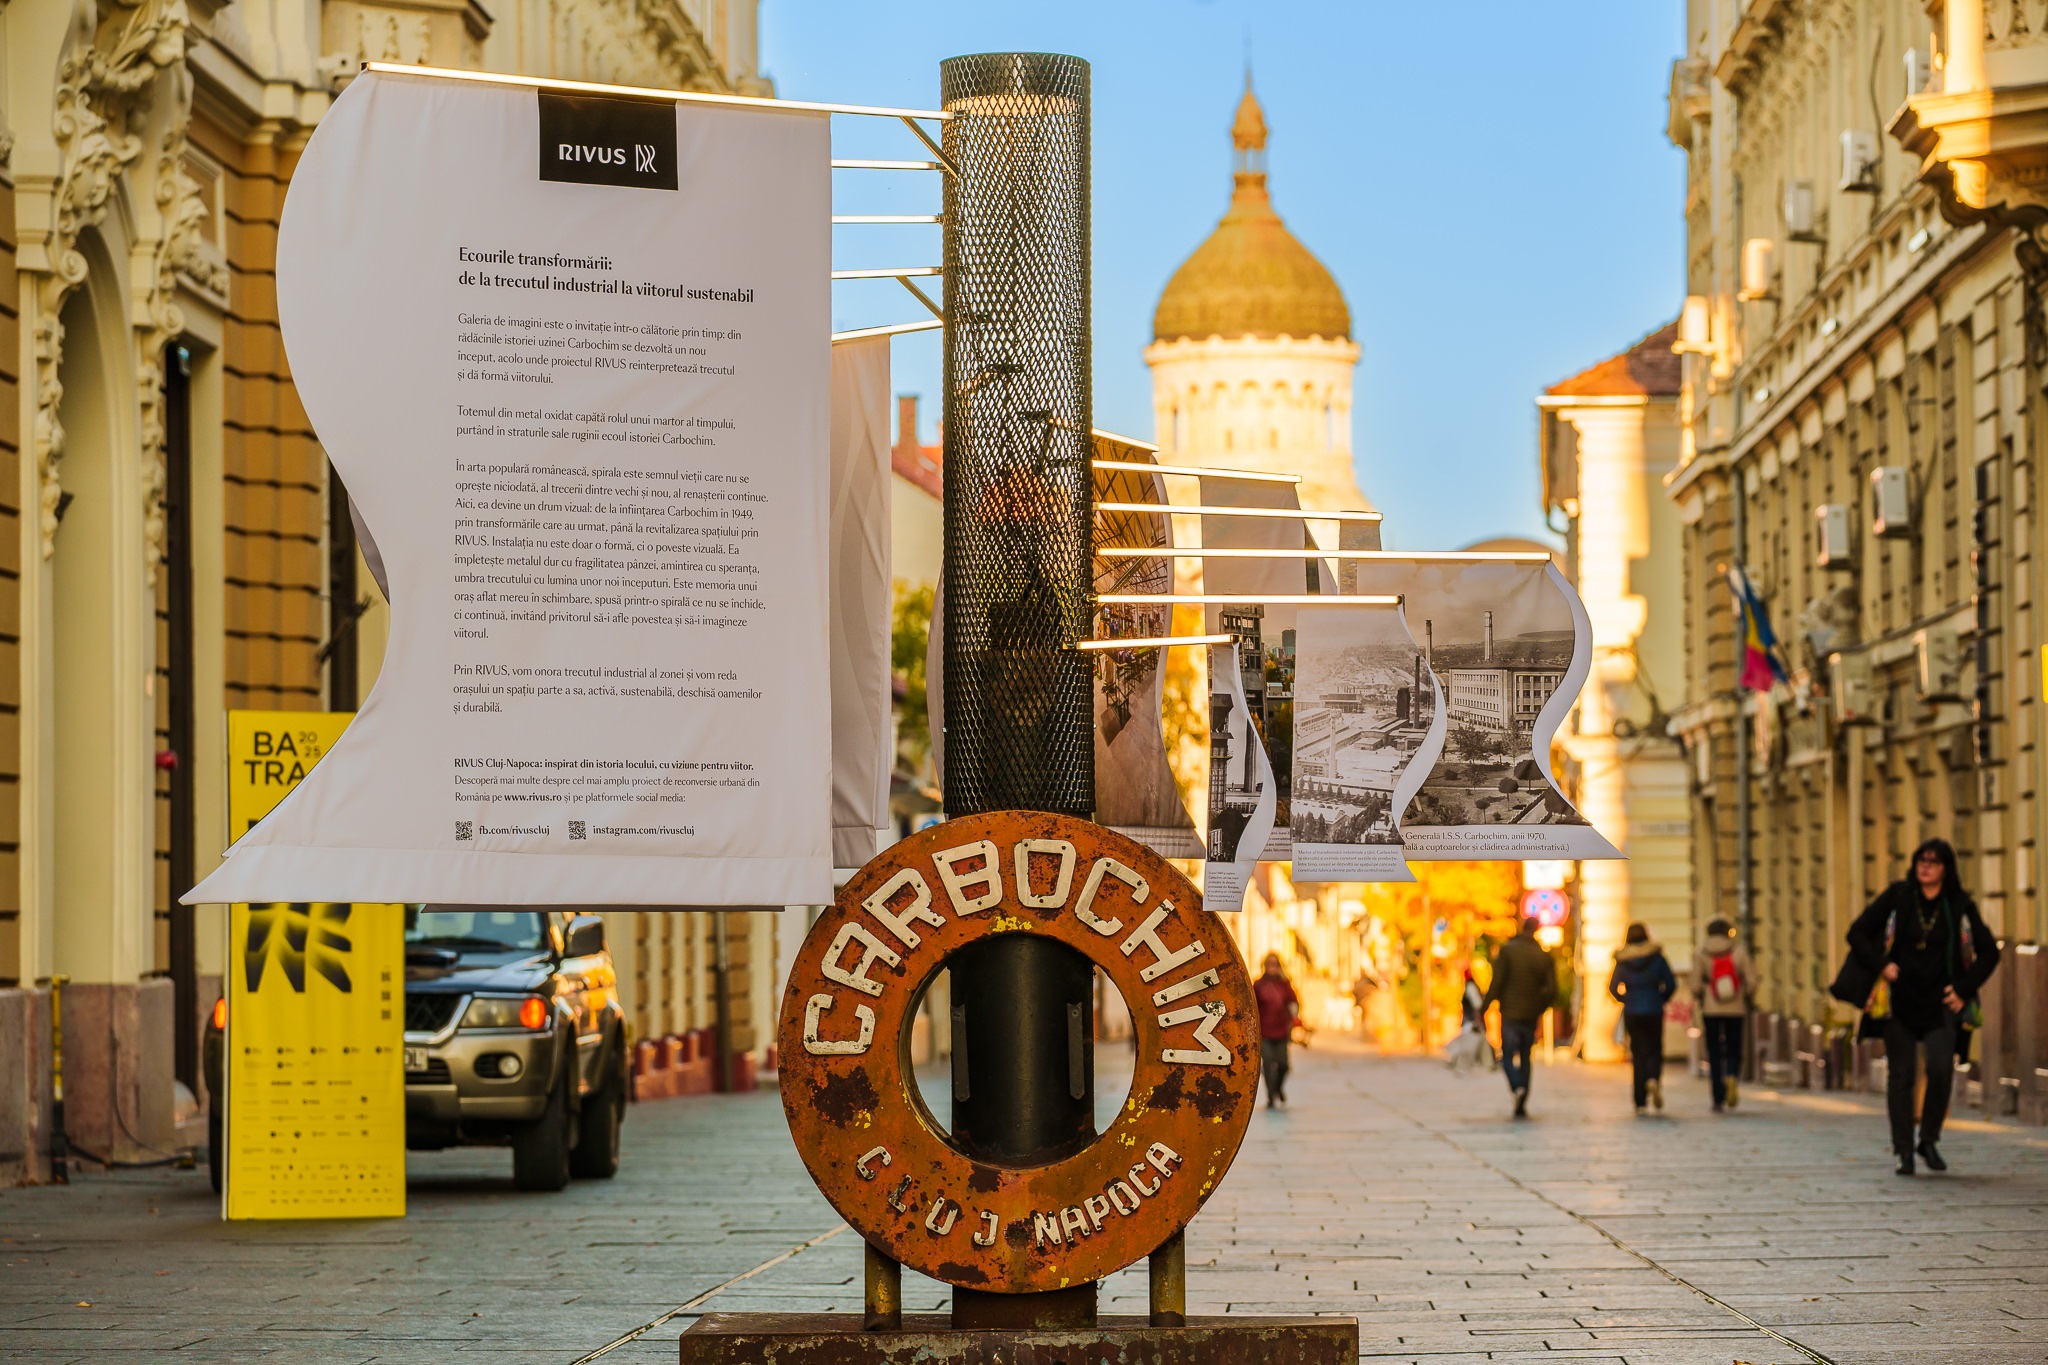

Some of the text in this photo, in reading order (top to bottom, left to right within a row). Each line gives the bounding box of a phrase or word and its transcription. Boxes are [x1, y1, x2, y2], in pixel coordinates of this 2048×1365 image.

[558, 143, 627, 165] RIVUS
[459, 246, 613, 271] Ecourile transformării:
[458, 270, 754, 303] de la trecutul industrial la viitorul sustenabil
[457, 312, 742, 342] Galeria de imagini este o invitație într-o călătorie prin timp: din
[458, 332, 706, 356] rădăcinile istoriei uzinei Carbochim se dezvoltă un nou
[457, 350, 735, 376] început, acolo unde proiectul RIVUS reinterpretează trecutul
[457, 368, 554, 384] și dă formă viitorului.
[456, 404, 736, 431] Totemul din metal oxidat capătă rolul unui martor al timpului,
[456, 424, 716, 446] purtând în straturile sale ruginii ecoul istoriei Carbochim.
[455, 458, 750, 484] În arta populară românească, spirala este semnul vieții care nu se
[453, 608, 748, 629] ci continuă, invitând privitorul să-i afle povestea și să-i imagineze
[453, 663, 738, 682] Prin RIVUS, vom onora trecutul industrial al zonei și vom reda
[452, 682, 763, 699] orașului un spațiu parte a sa, activă, sustenabilă, deschisă oamenilor
[254, 731, 297, 757] BA
[454, 757, 484, 768] RIVUS
[485, 757, 543, 771] Cluj-Napoca:
[544, 758, 579, 771] inspirat
[579, 758, 595, 769] din
[595, 759, 624, 769] istoria
[625, 759, 658, 770] locului,
[671, 760, 700, 770] viziune
[700, 762, 729, 772] pentru
[729, 761, 754, 771] viitor.
[454, 774, 760, 788] Descoperă mai multe despre cel mai amplu proiect de reconversie urbană din
[455, 791, 686, 804] România pe www.rivus.ro și pe platformele social media:
[478, 824, 550, 837] fb.com/rivuscluj
[592, 825, 695, 837] instagram.com/rivuscluj
[1464, 832, 1510, 841] Carbochim,
[1511, 832, 1525, 840] anii
[1425, 843, 1470, 852] cuptoarelor
[1480, 843, 1510, 851] clădirea
[803, 838, 1231, 1066] CARBOCHIM
[856, 1141, 1183, 1248] CLUJ NAPOCA
